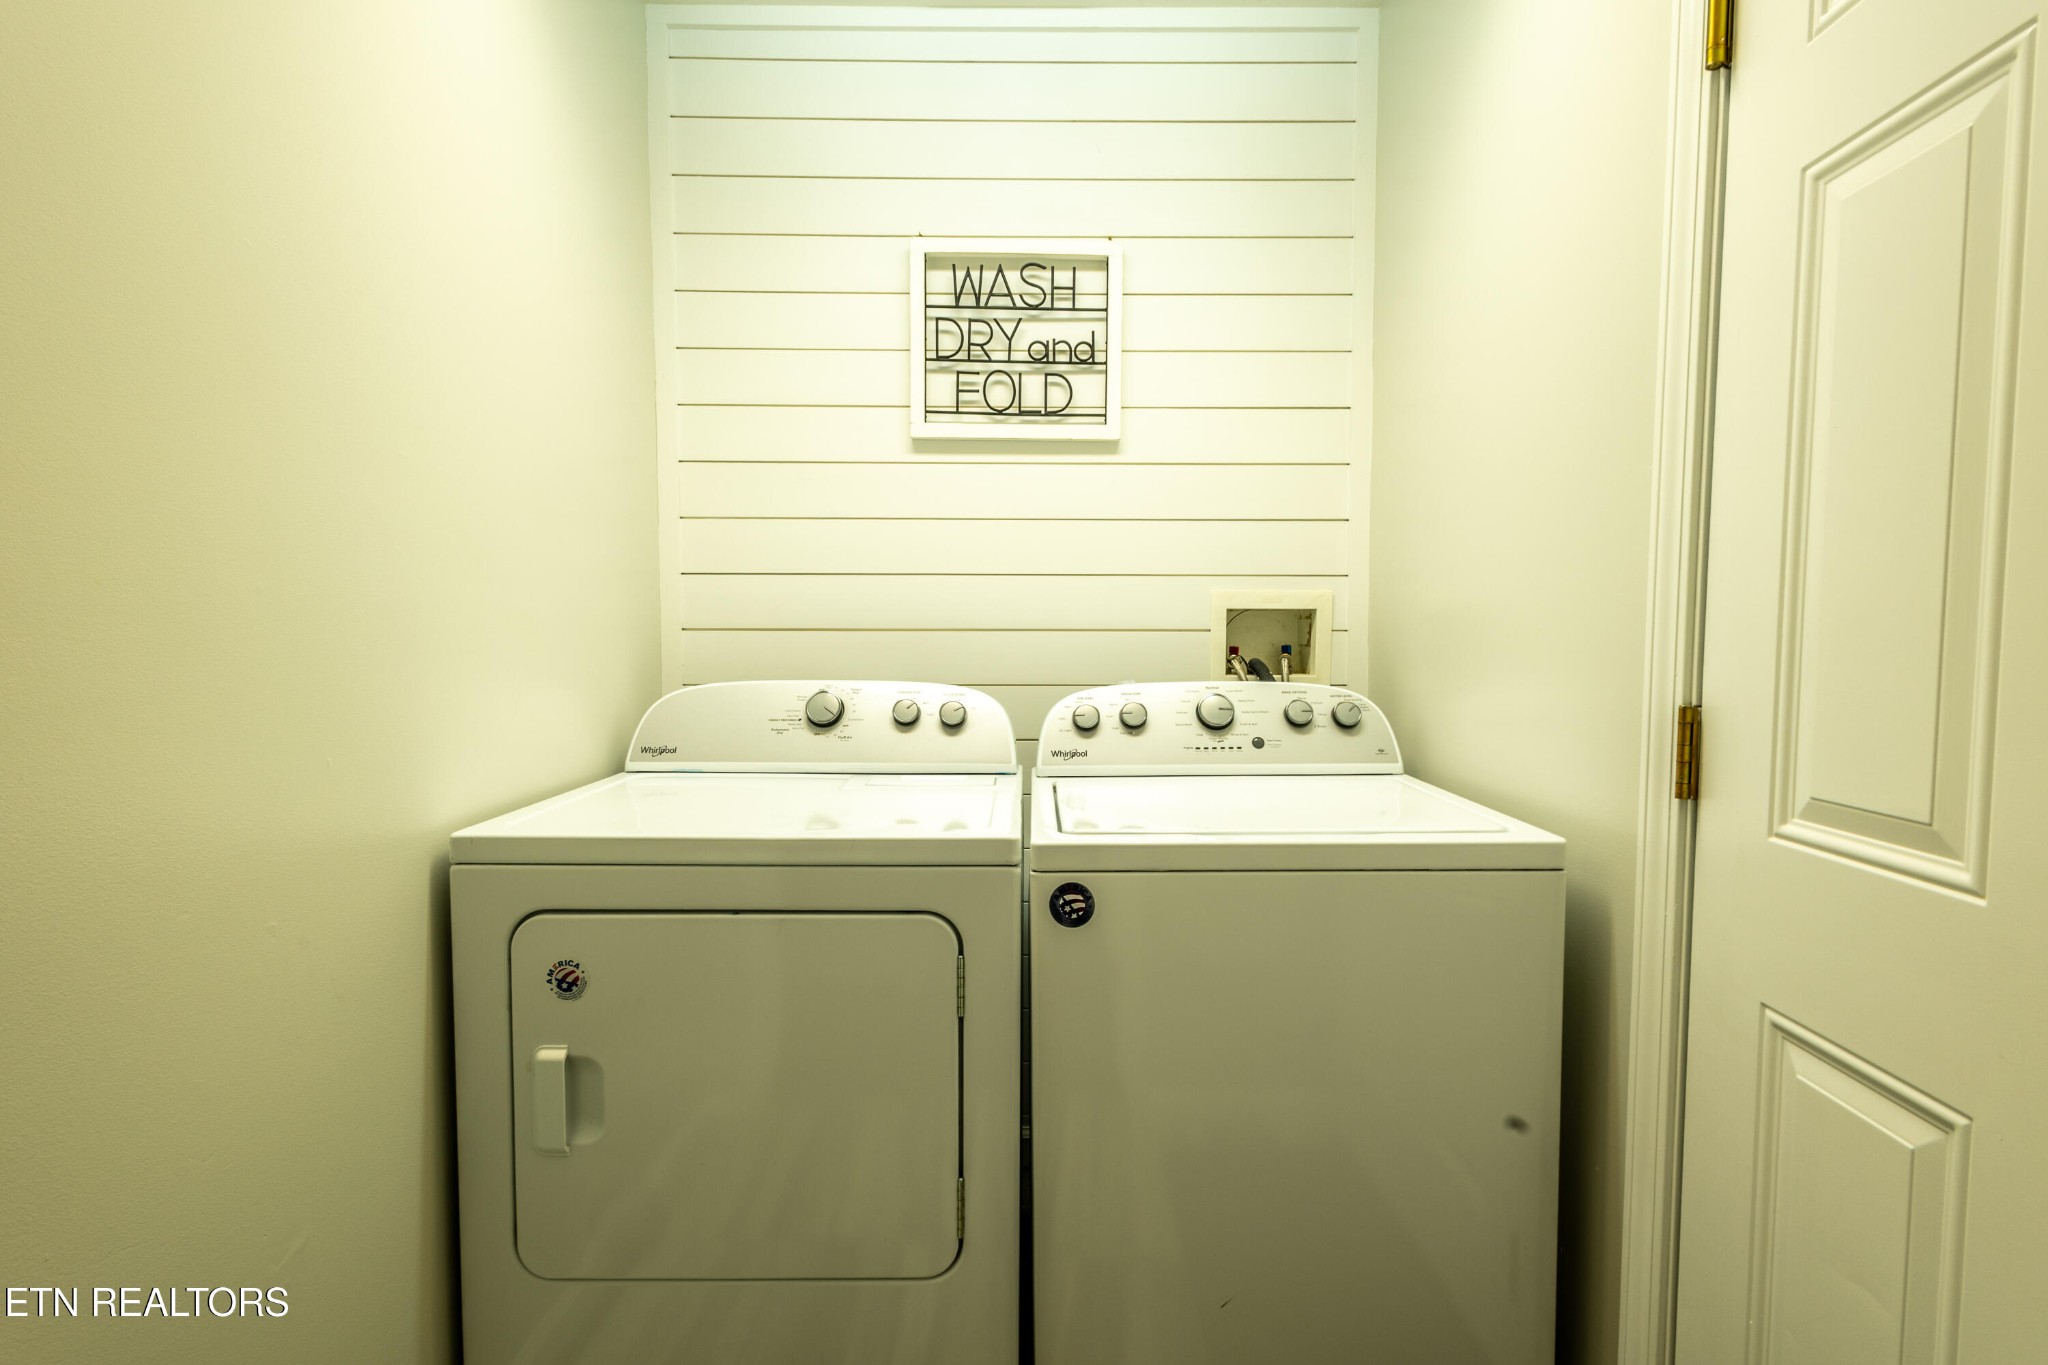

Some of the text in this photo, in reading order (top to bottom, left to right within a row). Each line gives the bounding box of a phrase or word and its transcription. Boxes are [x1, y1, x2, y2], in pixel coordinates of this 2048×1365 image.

[952, 262, 1076, 309] WASH
[935, 316, 1095, 363] DRY and
[956, 369, 1073, 414] FOLD
[640, 745, 677, 757] Whirlpool
[1050, 748, 1088, 761] Whirlpool
[546, 959, 580, 985] AMERICA
